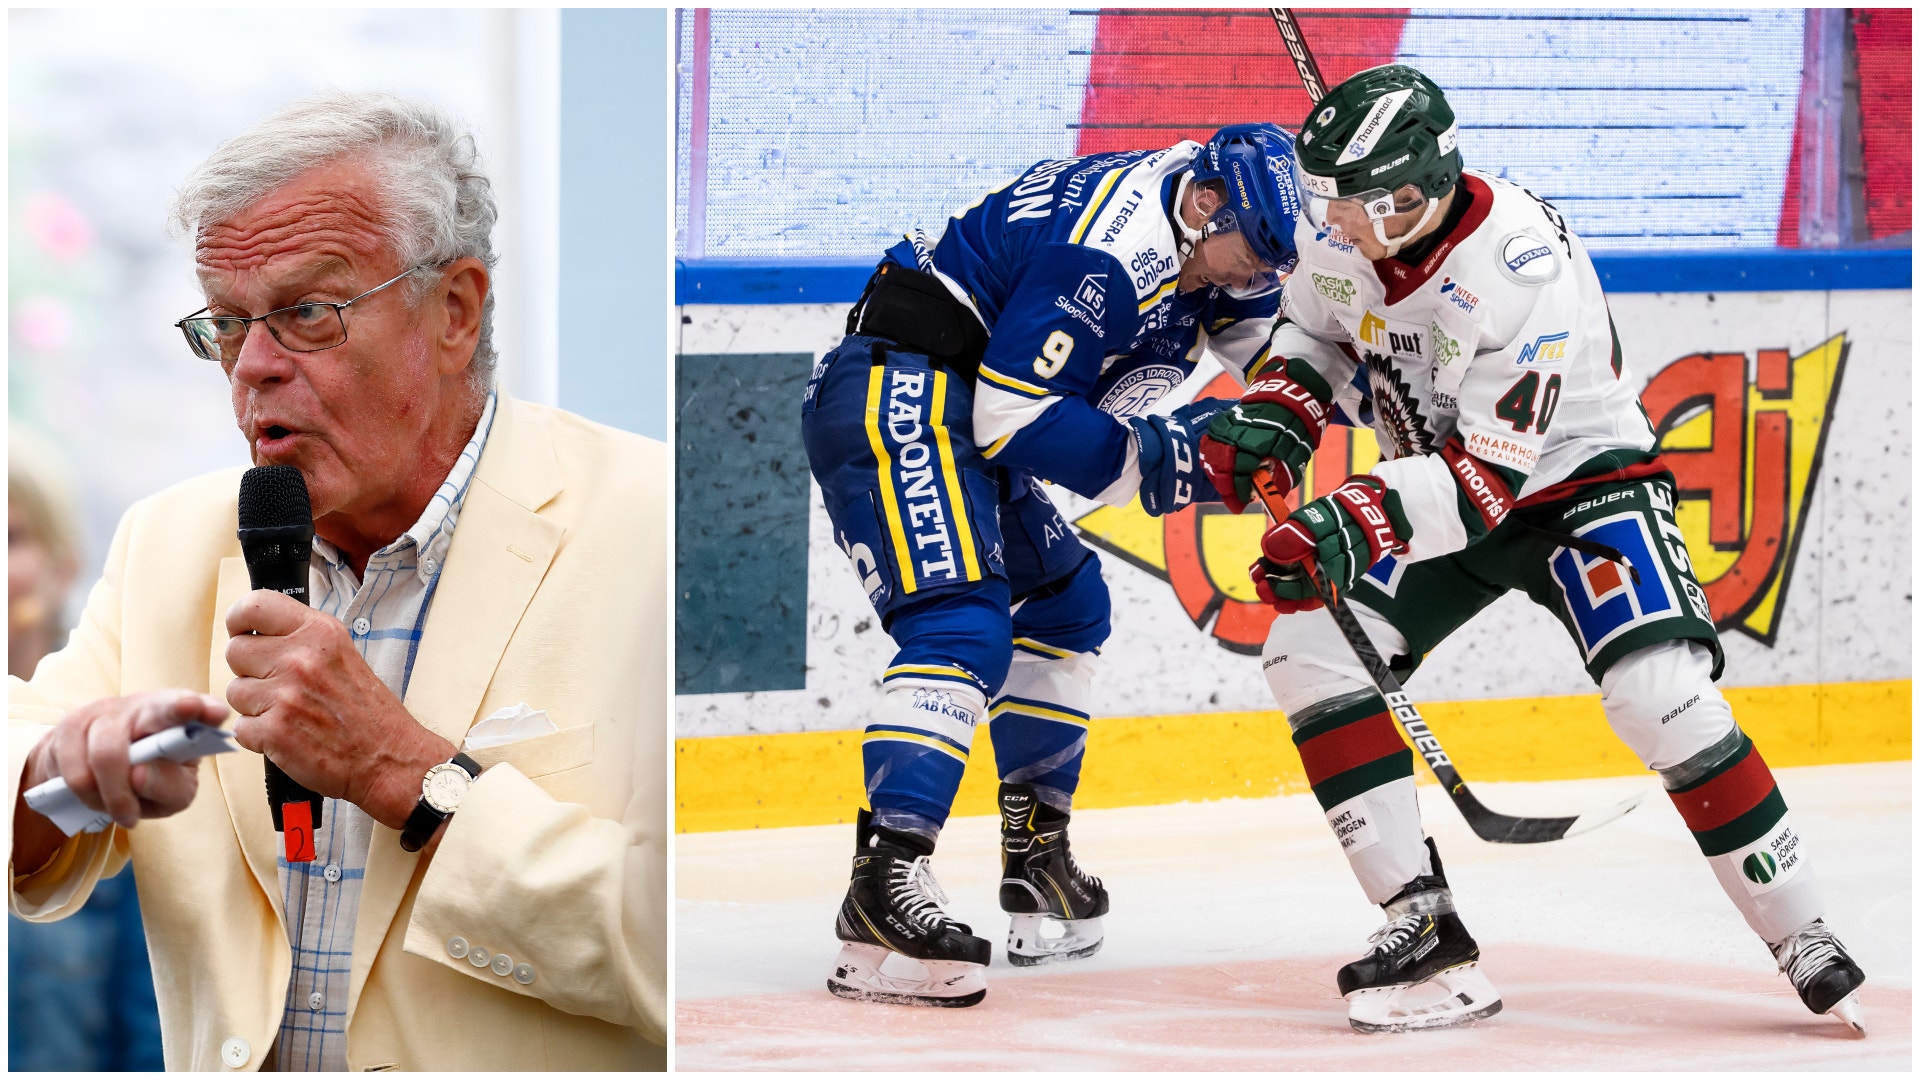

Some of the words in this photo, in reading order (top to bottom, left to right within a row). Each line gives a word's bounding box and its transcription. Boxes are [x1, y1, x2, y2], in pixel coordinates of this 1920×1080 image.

[1357, 97, 1393, 144] Tranpenad
[1208, 141, 1220, 171] CCM
[1371, 154, 1410, 176] BAUER
[1275, 175, 1291, 215] DÖRREN
[1283, 173, 1300, 222] LEKSANDS
[1101, 200, 1139, 243] TEGERA
[1131, 248, 1158, 272] clas
[1509, 247, 1550, 267] VOLVO
[1081, 285, 1105, 310] NS
[1312, 274, 1342, 290] CASH
[1455, 283, 1478, 307] INTER
[1054, 295, 1106, 338] Skoglunds
[1449, 292, 1475, 314] SPORT
[1032, 329, 1075, 380] 9
[1101, 372, 1145, 413] EKSANDS
[1495, 370, 1562, 435] 40
[888, 370, 958, 579] RADONETT
[1563, 489, 1635, 520] BAUER
[941, 704, 970, 725] KARL
[1661, 694, 1701, 725] BAUER
[1385, 691, 1452, 769] BAUER
[290, 826, 307, 860] 2
[1770, 827, 1792, 851] SANKT
[1780, 851, 1799, 873] PARK
[886, 914, 916, 940] CCM
